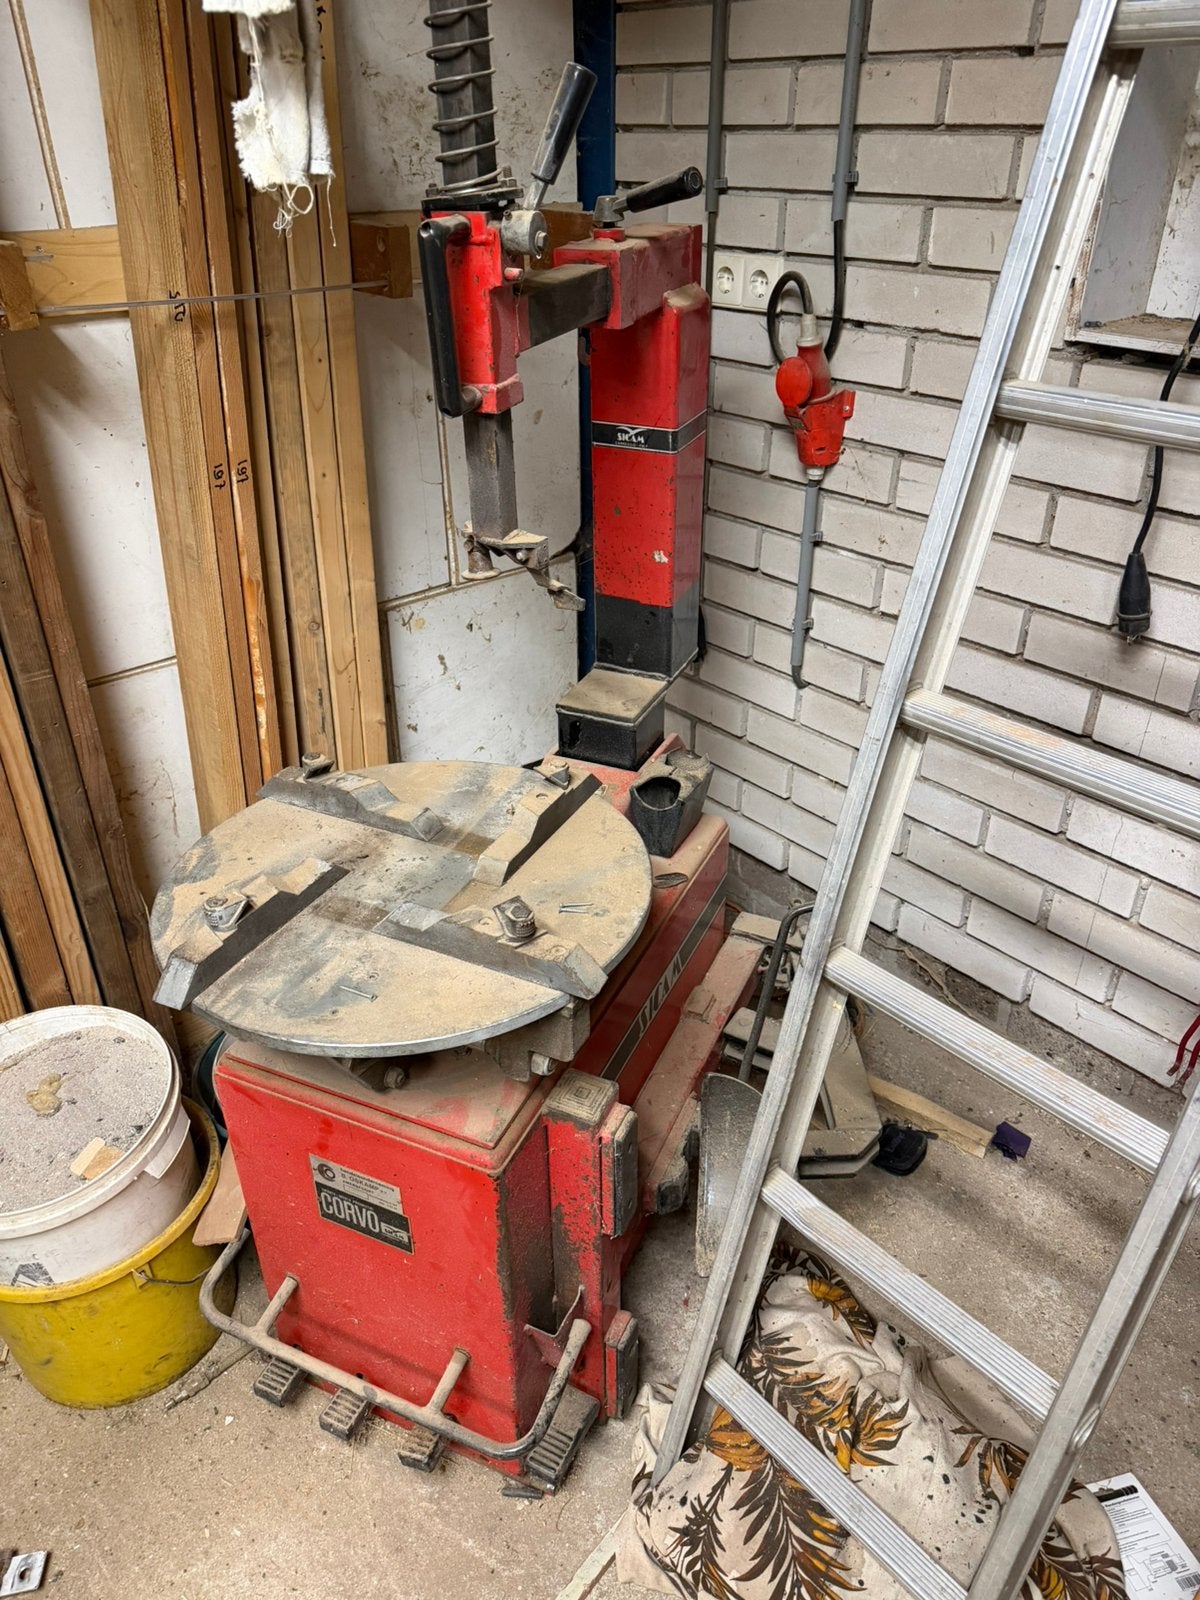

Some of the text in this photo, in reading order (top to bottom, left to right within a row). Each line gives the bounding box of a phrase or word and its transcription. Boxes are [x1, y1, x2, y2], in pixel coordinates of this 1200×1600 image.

[616, 432, 645, 444] SICAM
[213, 463, 226, 490] 197
[237, 459, 249, 484] 197
[638, 954, 684, 1037] SICAM
[320, 1191, 380, 1233] CORVO
